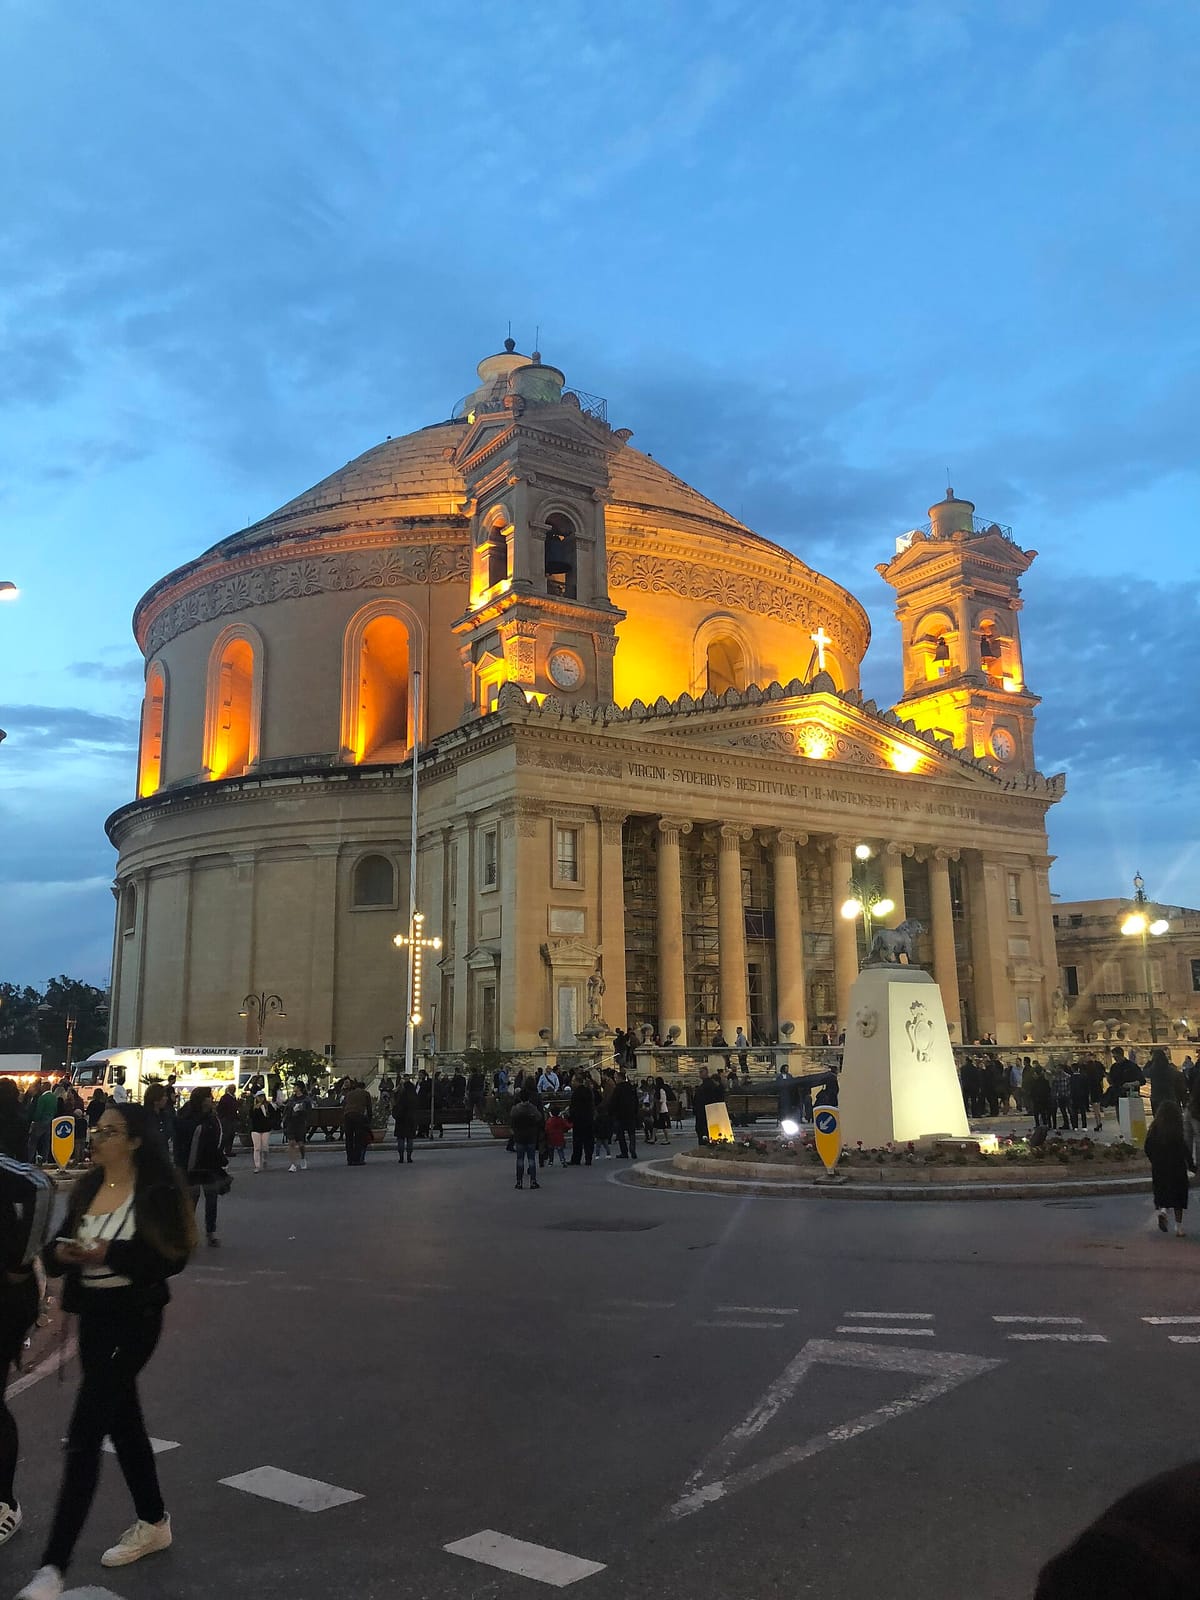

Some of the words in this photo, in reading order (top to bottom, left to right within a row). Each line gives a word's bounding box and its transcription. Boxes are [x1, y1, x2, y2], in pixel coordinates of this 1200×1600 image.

[627, 762, 666, 780] VIRGINI
[672, 768, 731, 788] SYDERIBVS
[736, 777, 798, 797] RESTITVTAE
[802, 786, 809, 798] T
[243, 1048, 264, 1056] CREAM
